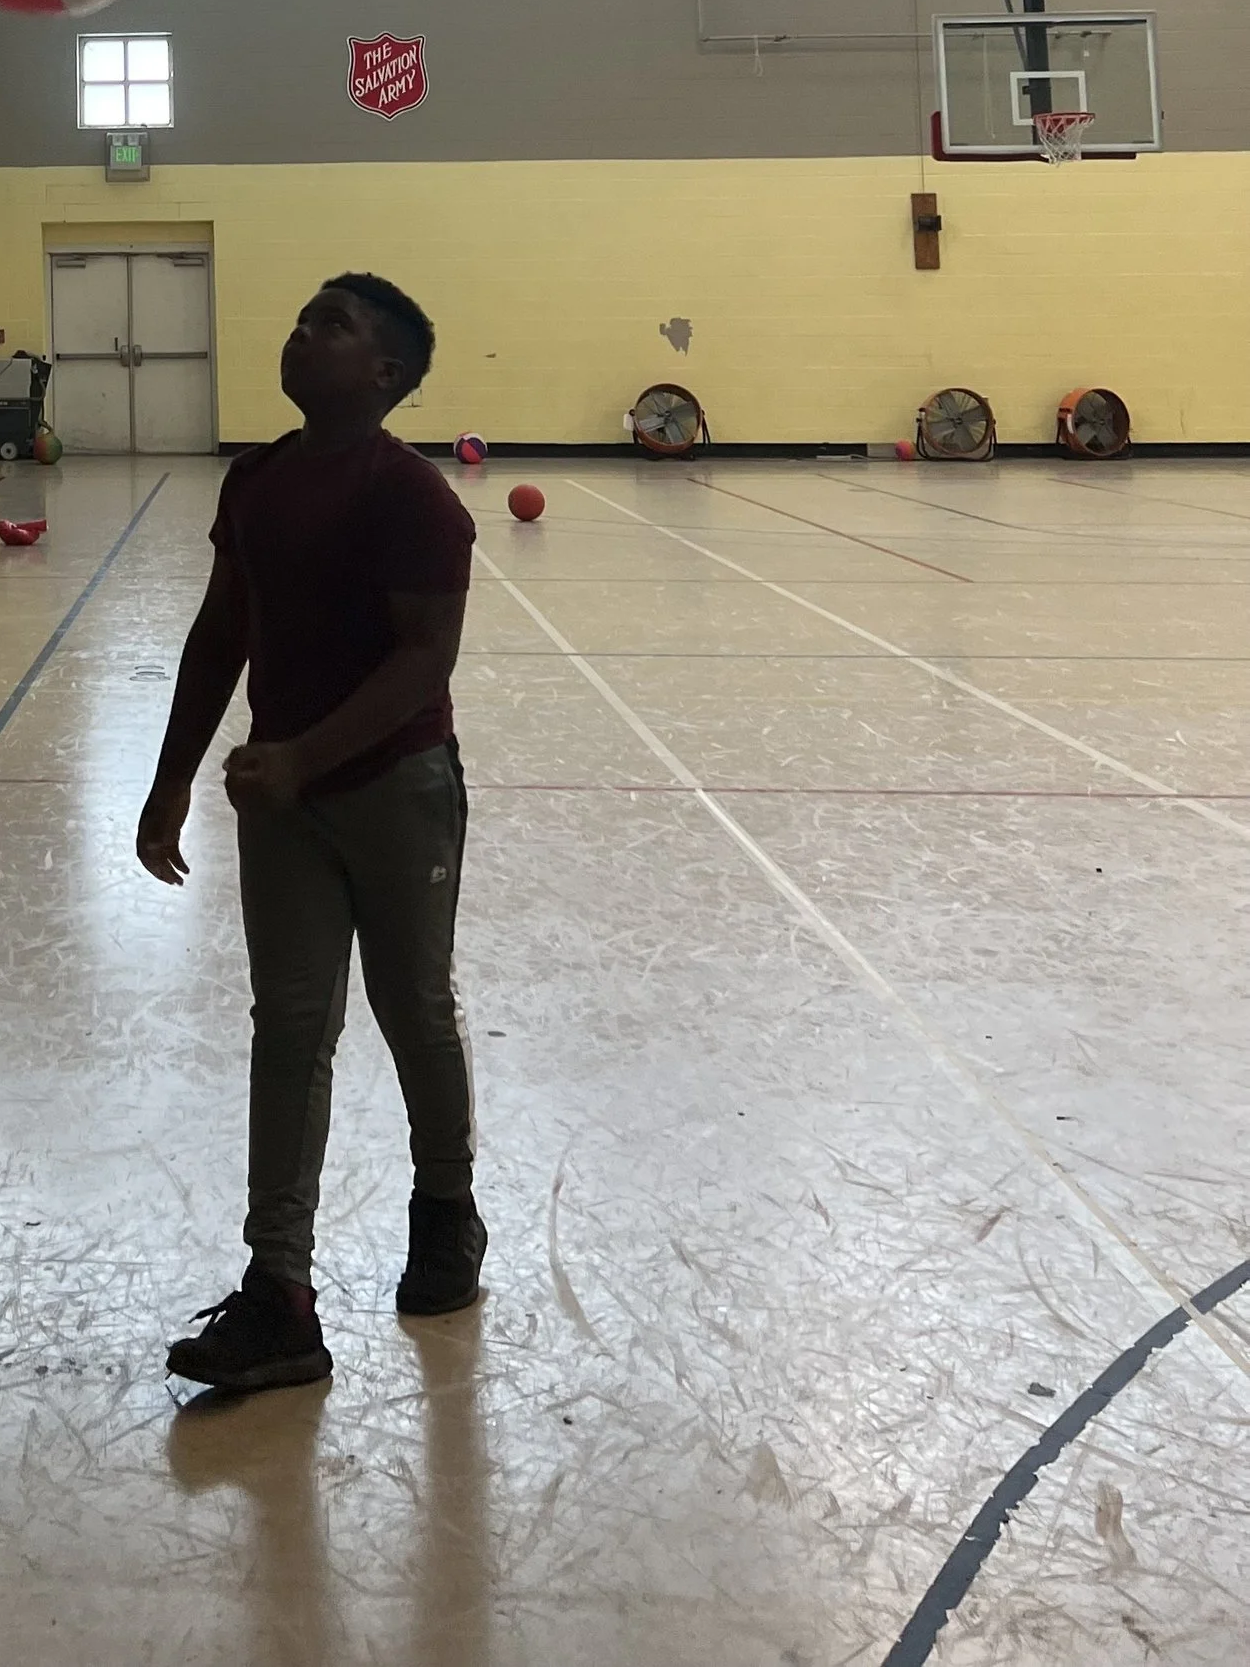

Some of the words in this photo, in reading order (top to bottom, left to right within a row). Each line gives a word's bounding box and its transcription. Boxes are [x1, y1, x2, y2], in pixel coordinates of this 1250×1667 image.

[355, 45, 417, 97] SALVATION
[363, 42, 392, 70] THE
[378, 69, 416, 108] ARMY
[115, 147, 139, 163] EXIT
